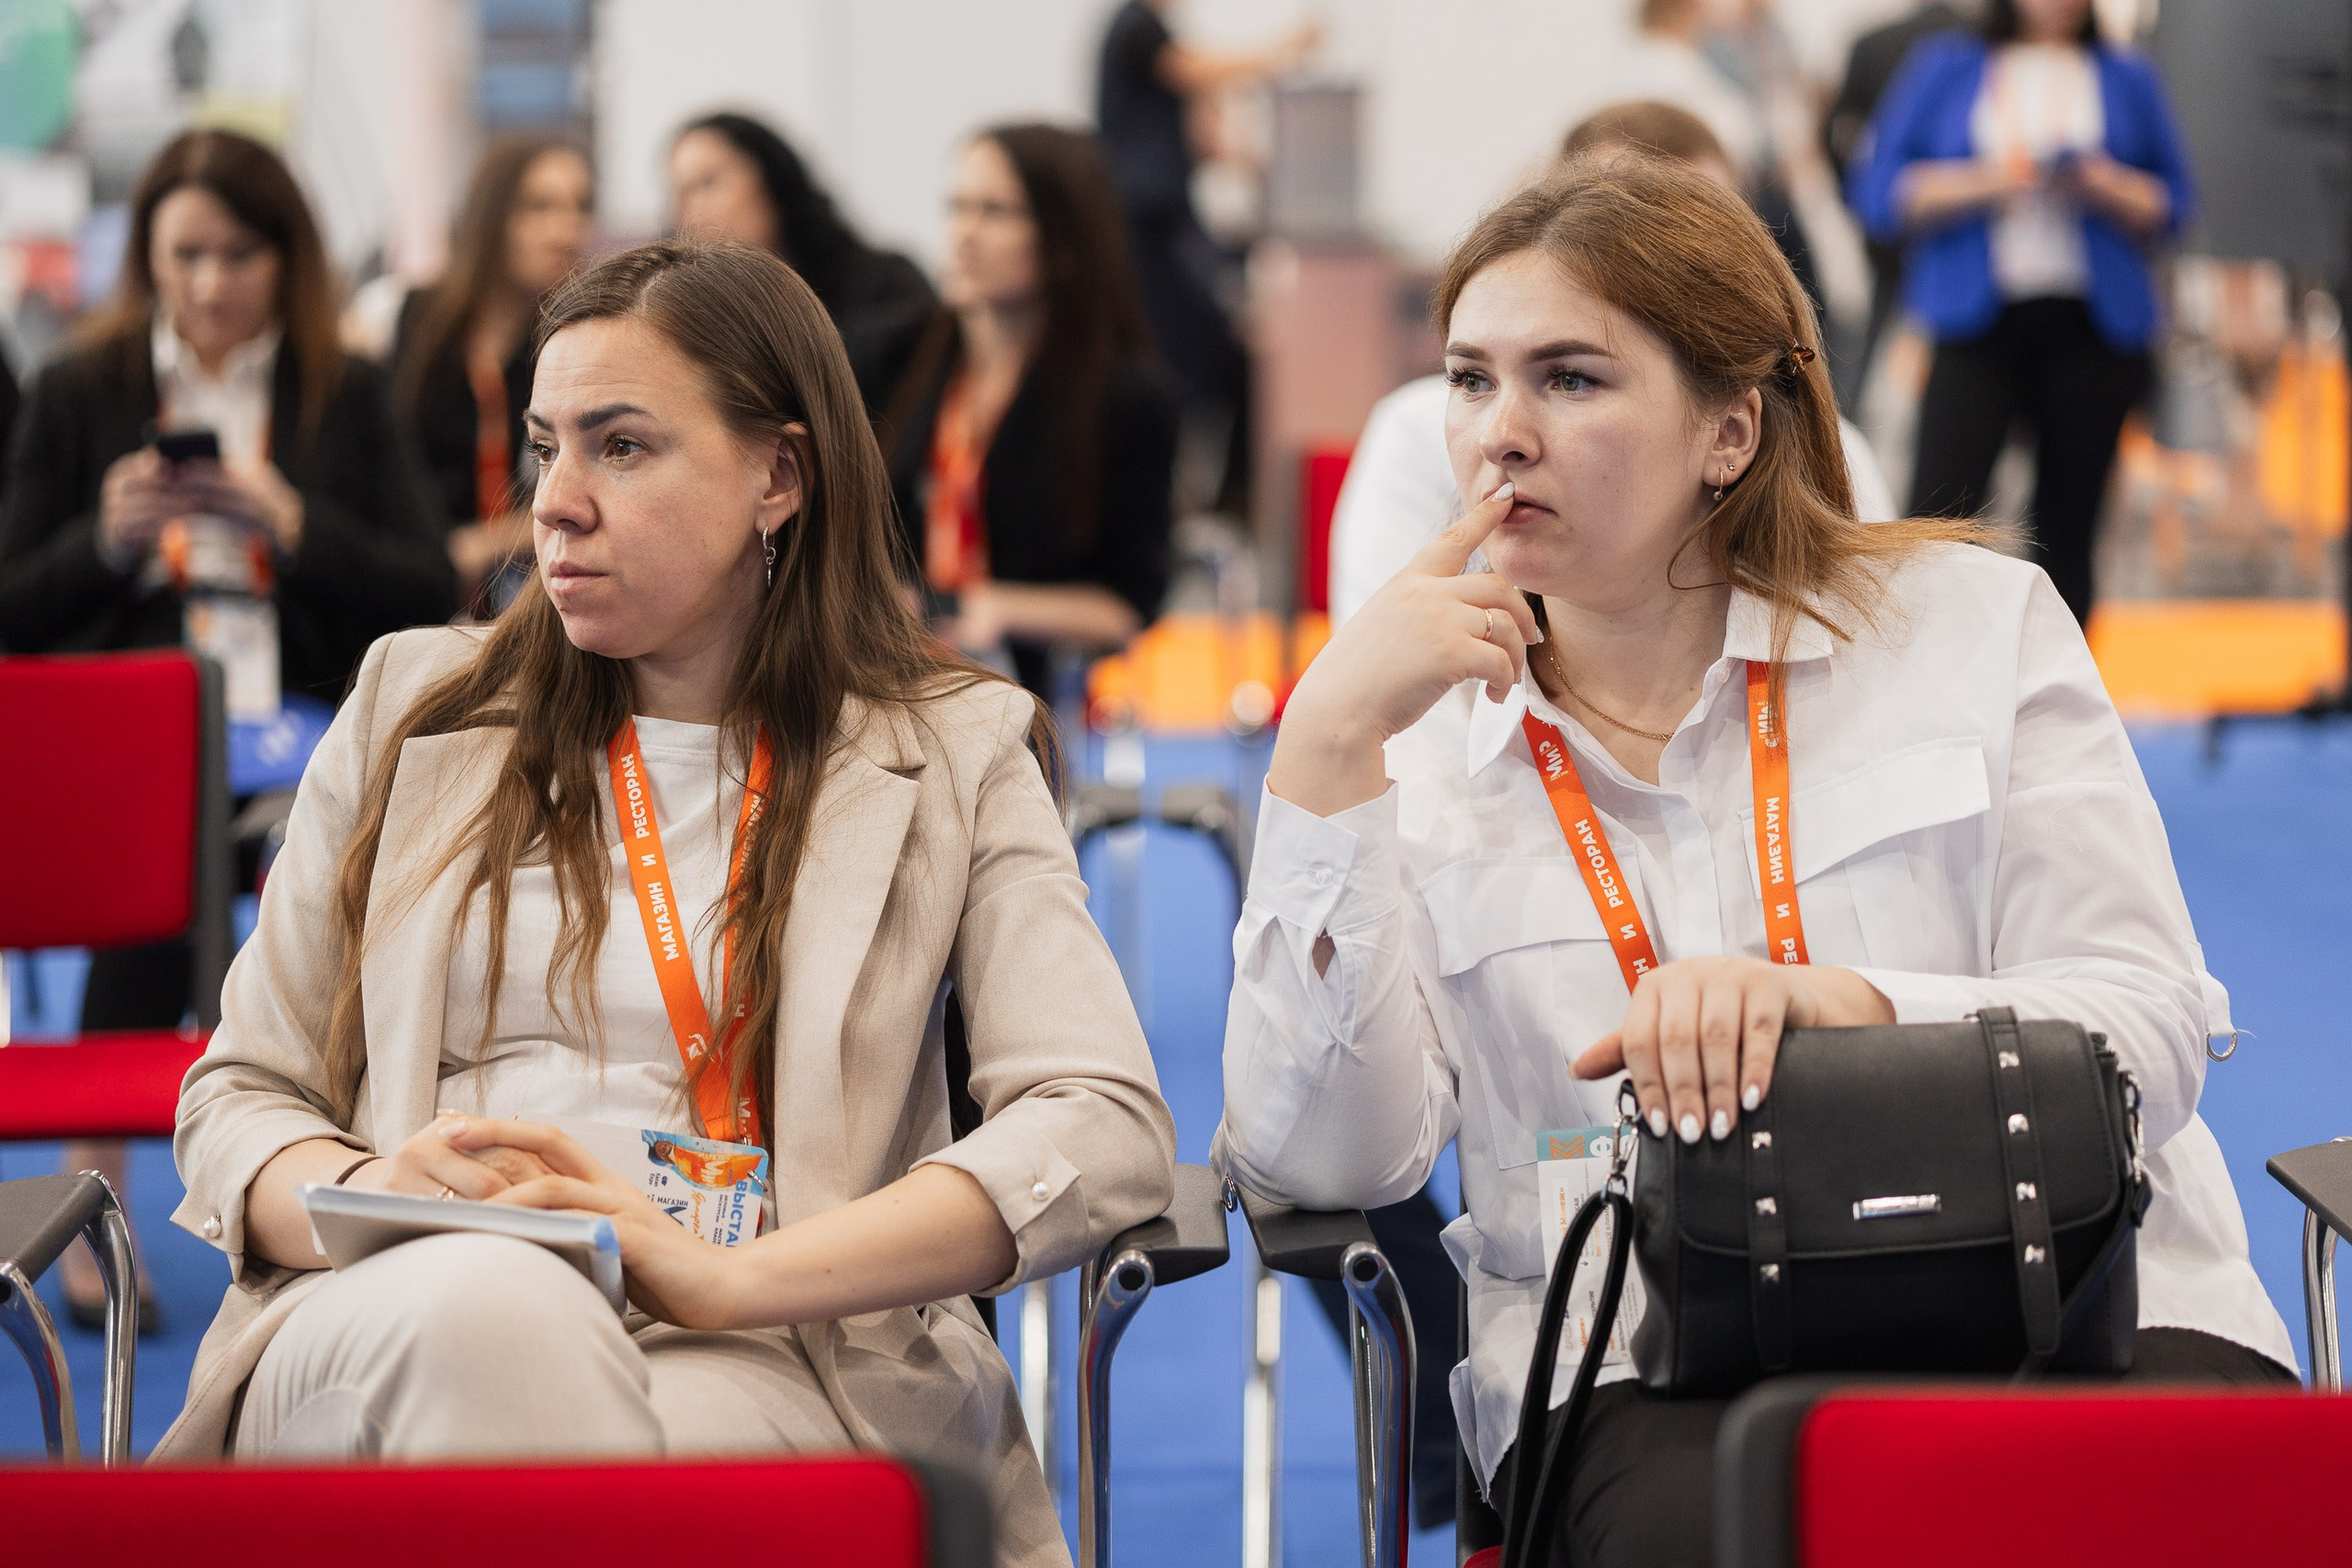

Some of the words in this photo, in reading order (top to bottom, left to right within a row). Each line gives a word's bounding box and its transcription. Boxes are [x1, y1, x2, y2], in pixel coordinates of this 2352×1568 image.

[621, 753, 650, 839] РЕСТОРАН
[642, 853, 657, 867] И
[1575, 818, 1623, 908] РЕСТОРАН
[1766, 796, 1785, 885] МАГАЗИН
[1776, 903, 1790, 919] И
[648, 882, 679, 961] МАГАЗИН
[1620, 923, 1637, 940] И
[657, 1196, 689, 1207] МАГАЗИН
